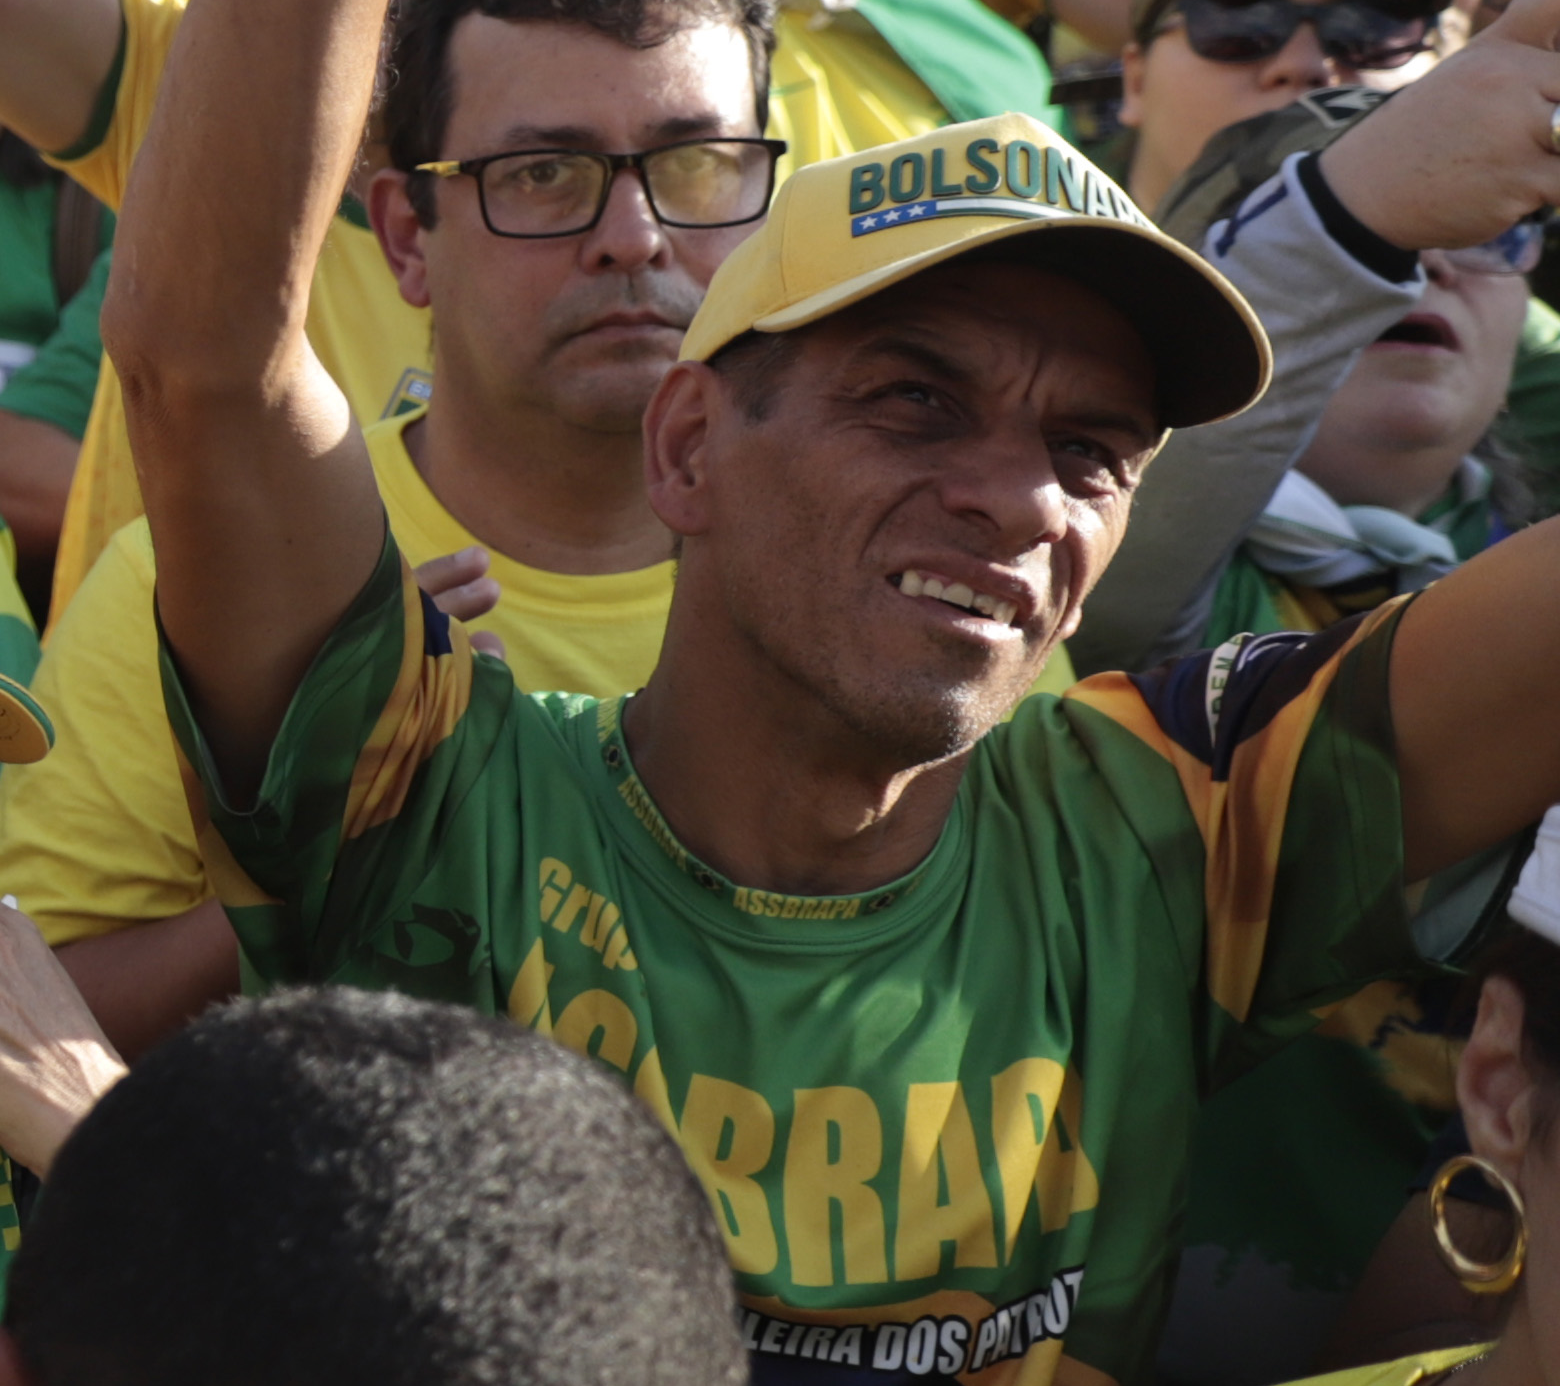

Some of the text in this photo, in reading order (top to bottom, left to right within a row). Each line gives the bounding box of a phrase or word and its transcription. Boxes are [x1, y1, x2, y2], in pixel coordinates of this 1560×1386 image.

[538, 856, 639, 971] Grup
[732, 886, 863, 920] ASSBRAPA
[741, 1310, 862, 1367] LEIRA
[871, 1317, 968, 1376] DOS
